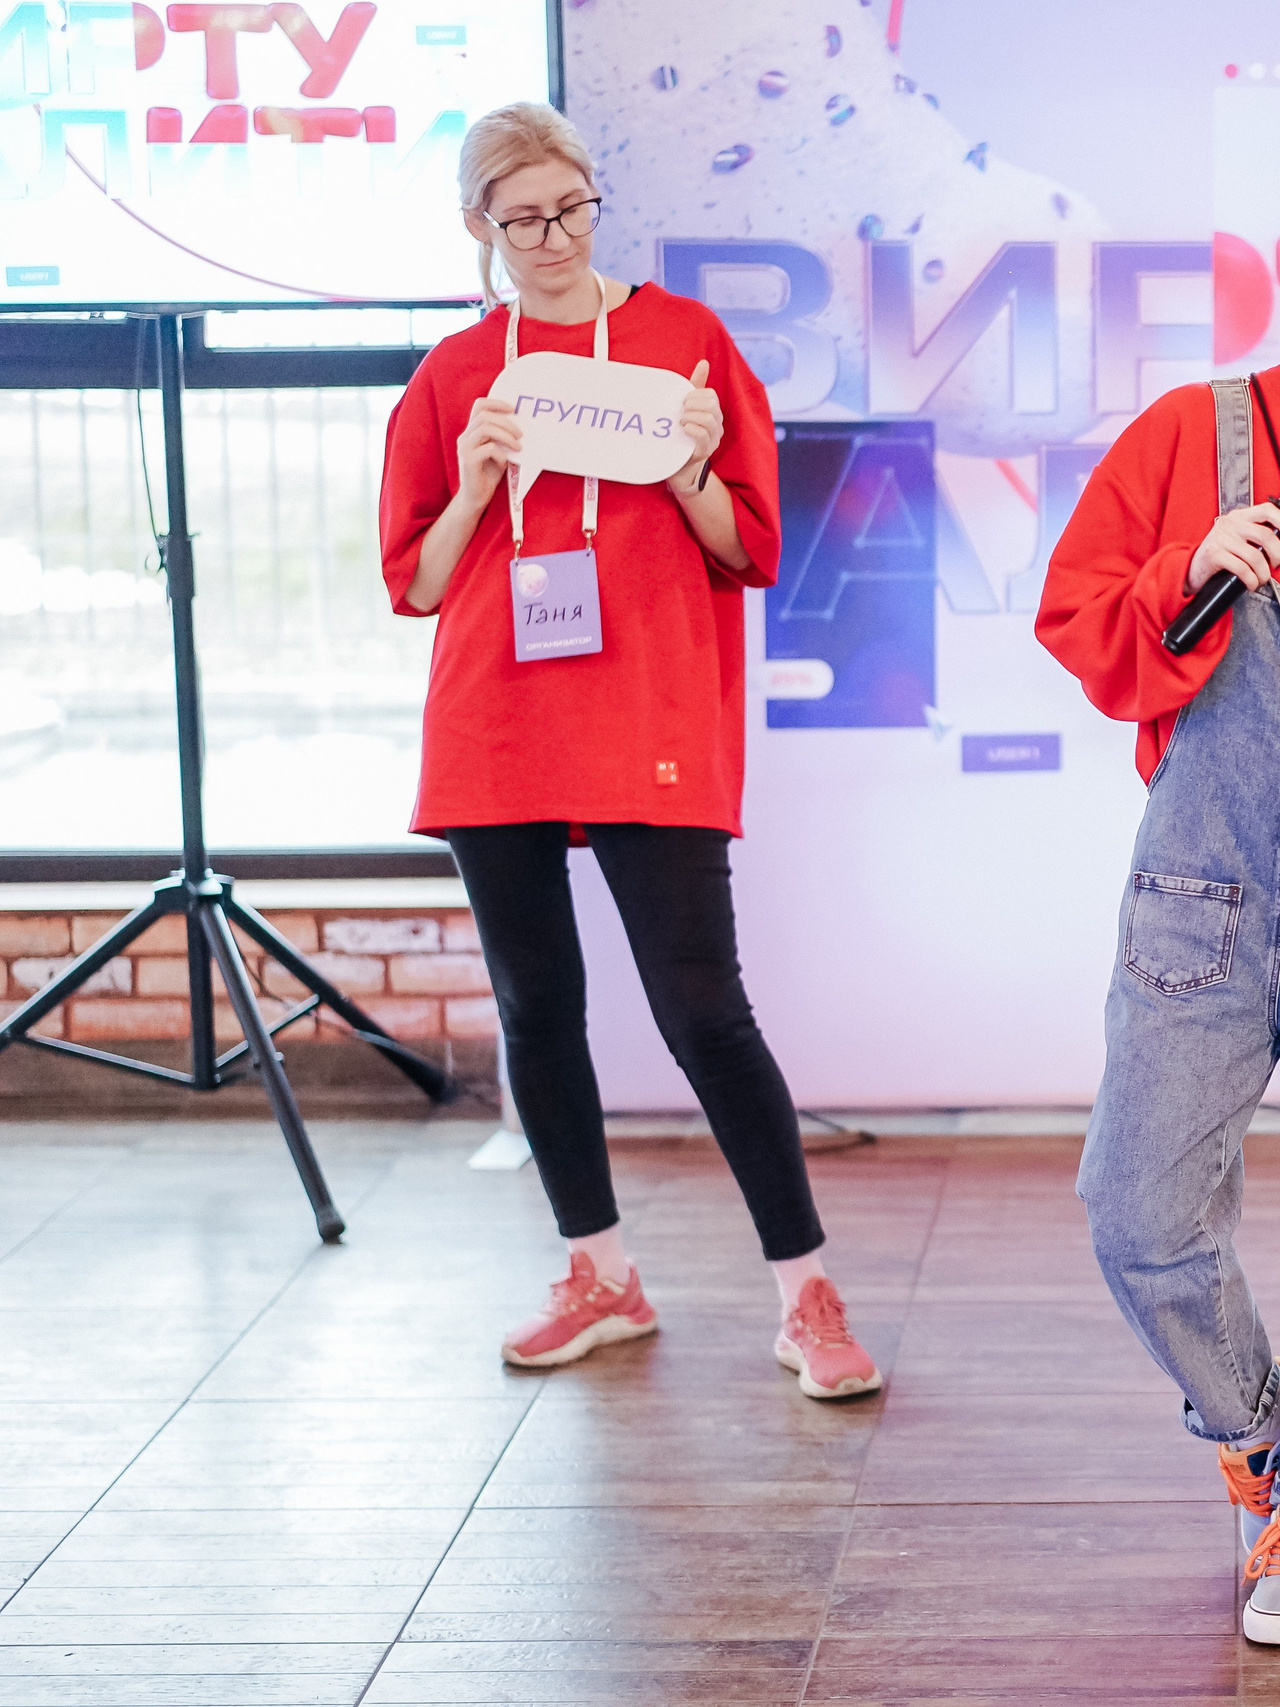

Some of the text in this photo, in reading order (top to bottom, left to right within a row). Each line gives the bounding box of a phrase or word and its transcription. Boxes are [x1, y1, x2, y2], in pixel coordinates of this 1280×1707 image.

[513, 394, 674, 439] ГРУППА 3
[523, 601, 583, 626] Таня
[526, 636, 593, 652] ОРГАНИЗАТОР
